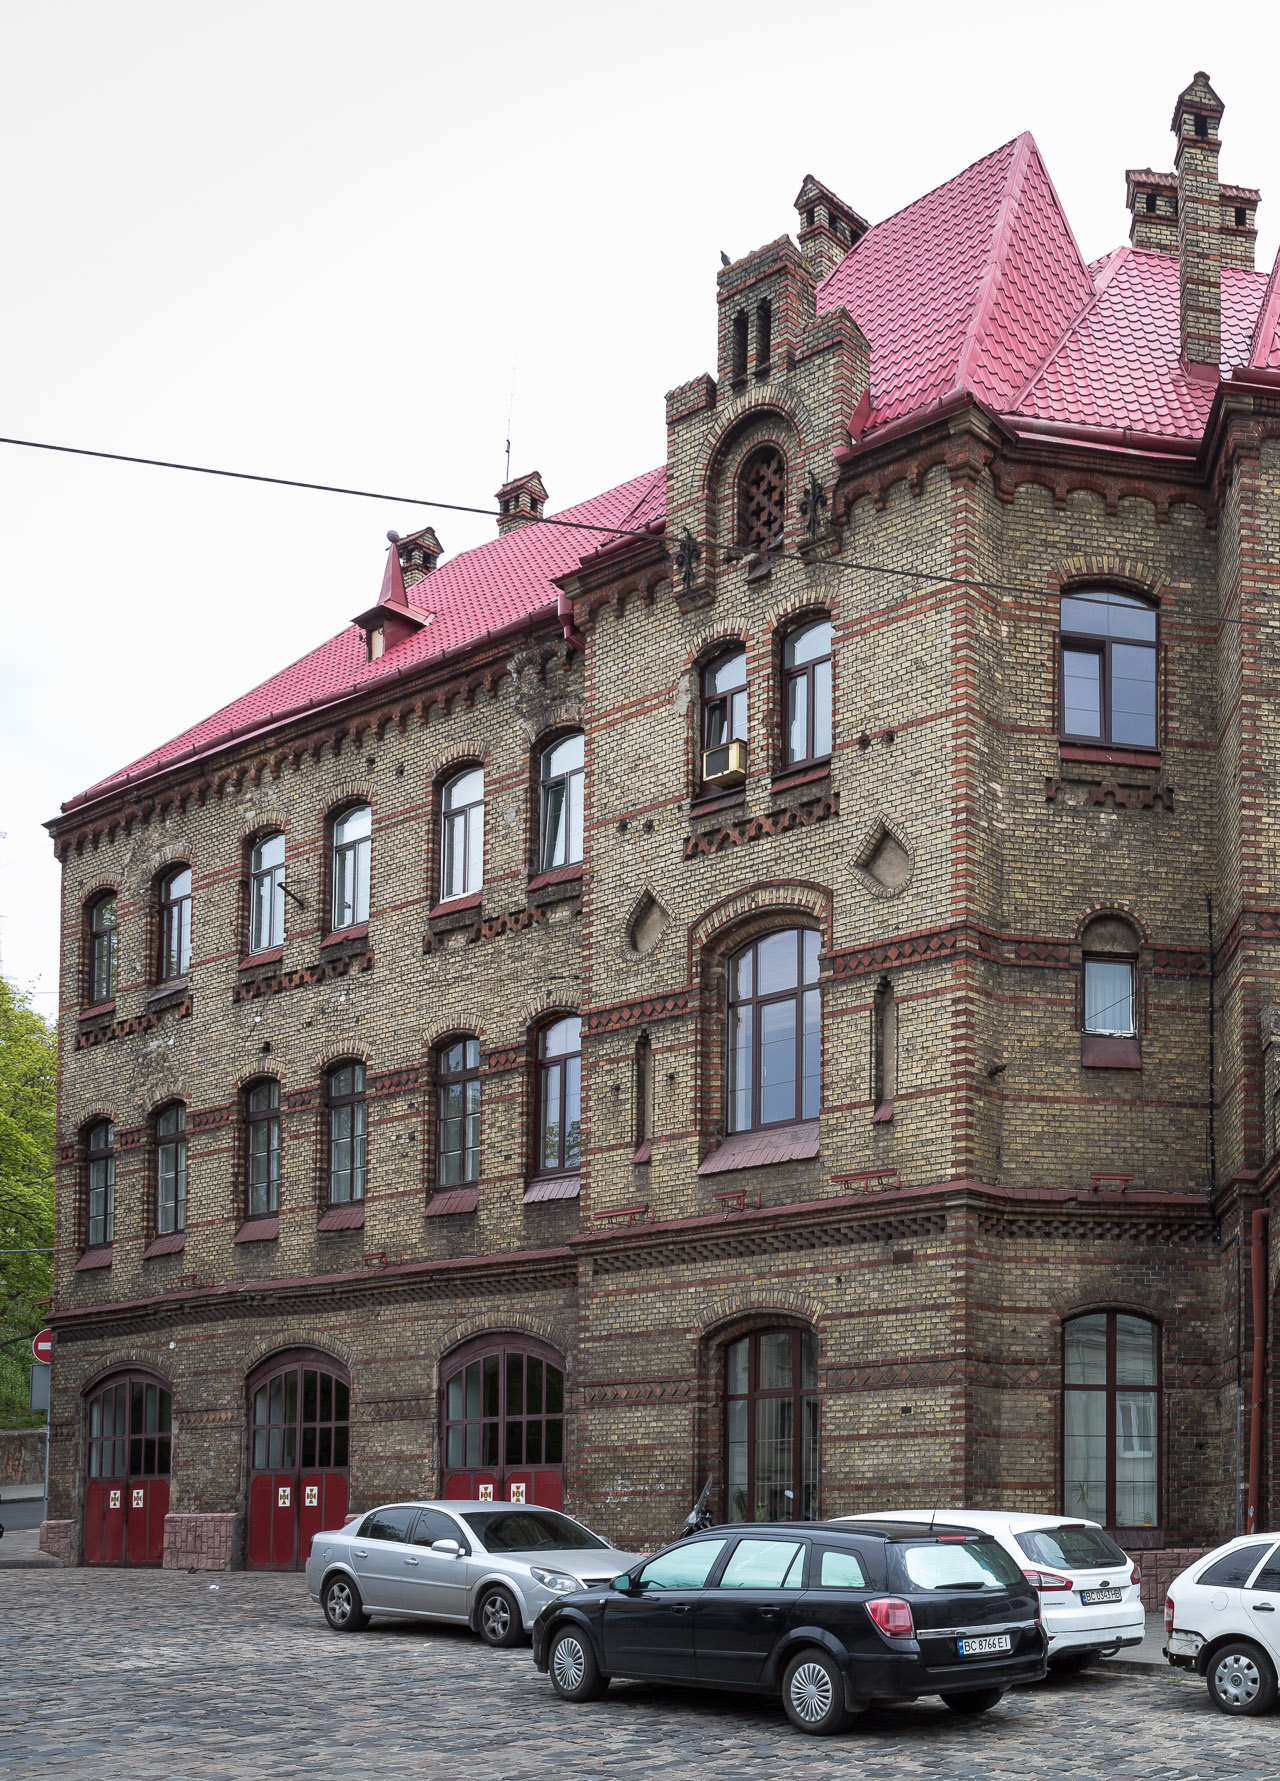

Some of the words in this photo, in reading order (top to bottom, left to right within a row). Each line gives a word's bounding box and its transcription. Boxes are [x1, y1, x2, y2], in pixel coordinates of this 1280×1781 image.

[1086, 1592, 1096, 1602] BC
[964, 1641, 977, 1653] BC
[978, 1639, 997, 1651] 8766
